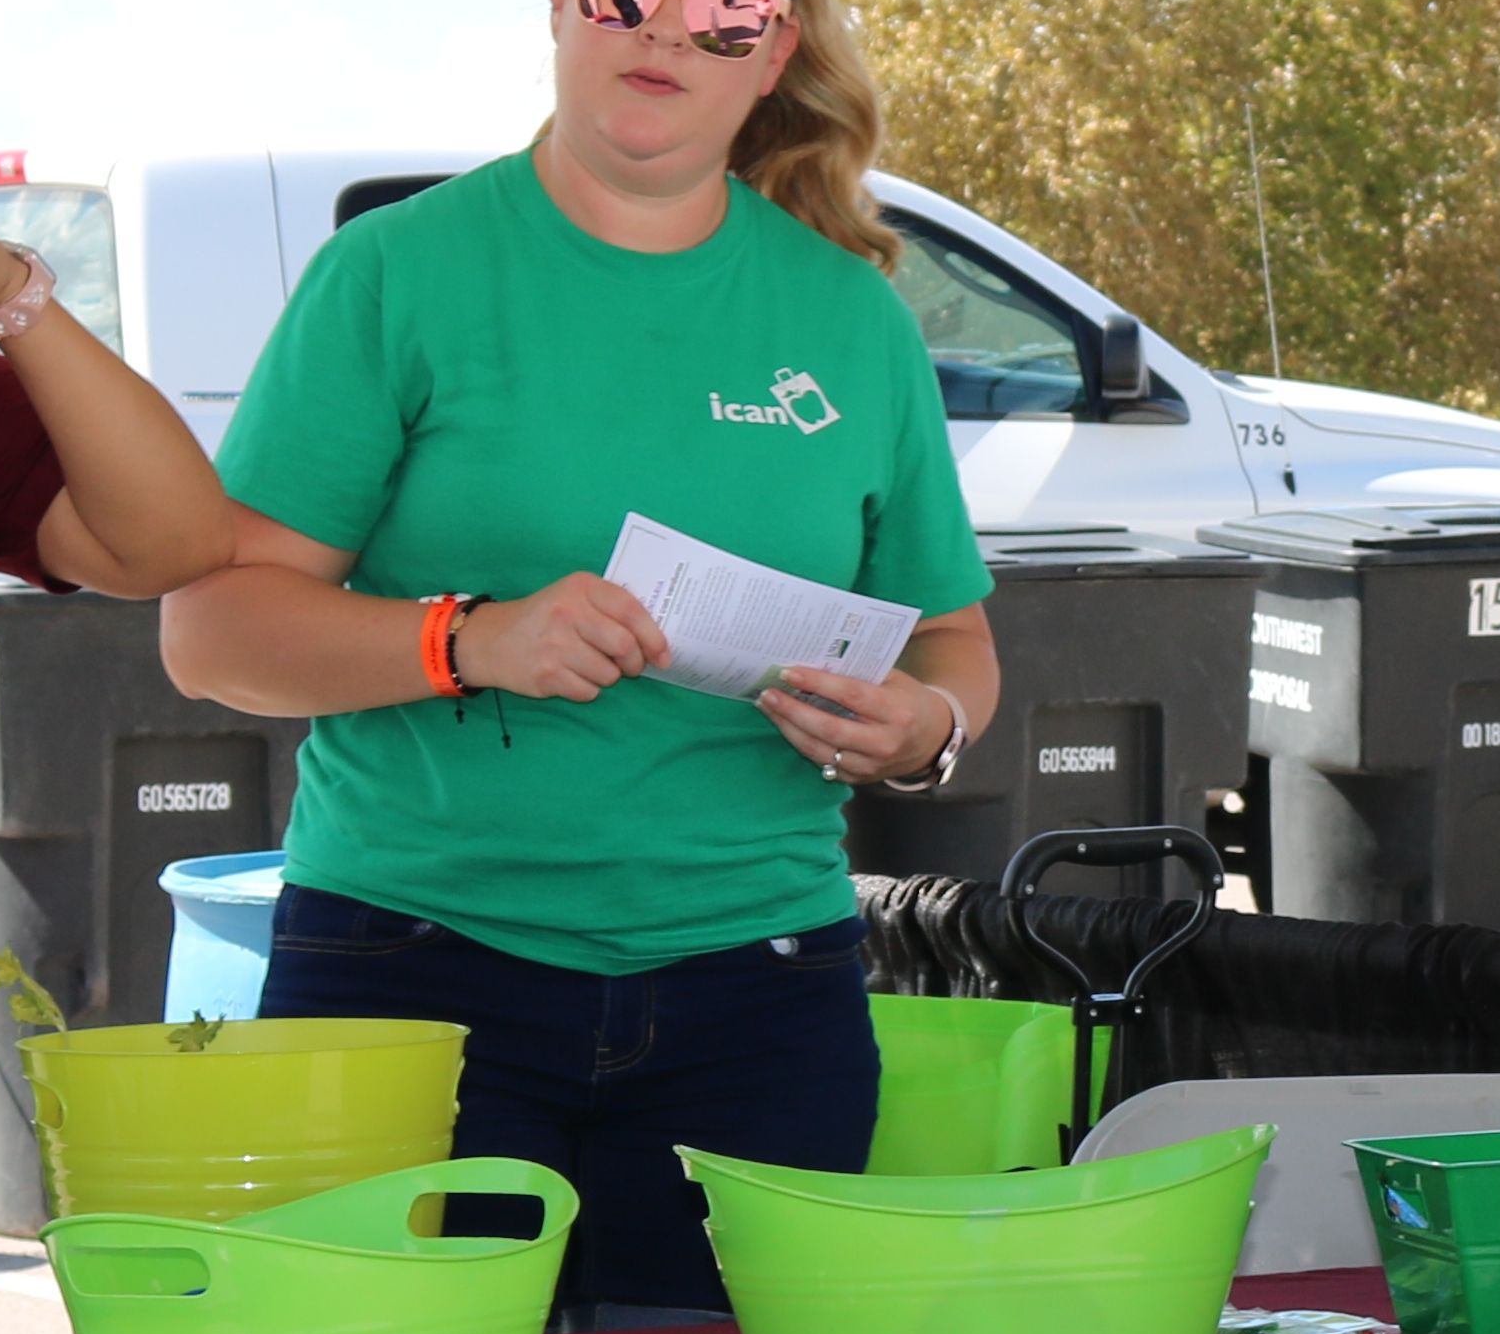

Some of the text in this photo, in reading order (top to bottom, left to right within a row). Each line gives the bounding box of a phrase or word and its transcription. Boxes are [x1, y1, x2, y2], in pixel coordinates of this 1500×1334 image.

[708, 391, 790, 426] ican
[1237, 424, 1286, 446] 736
[1251, 612, 1323, 656] OUTHWEST
